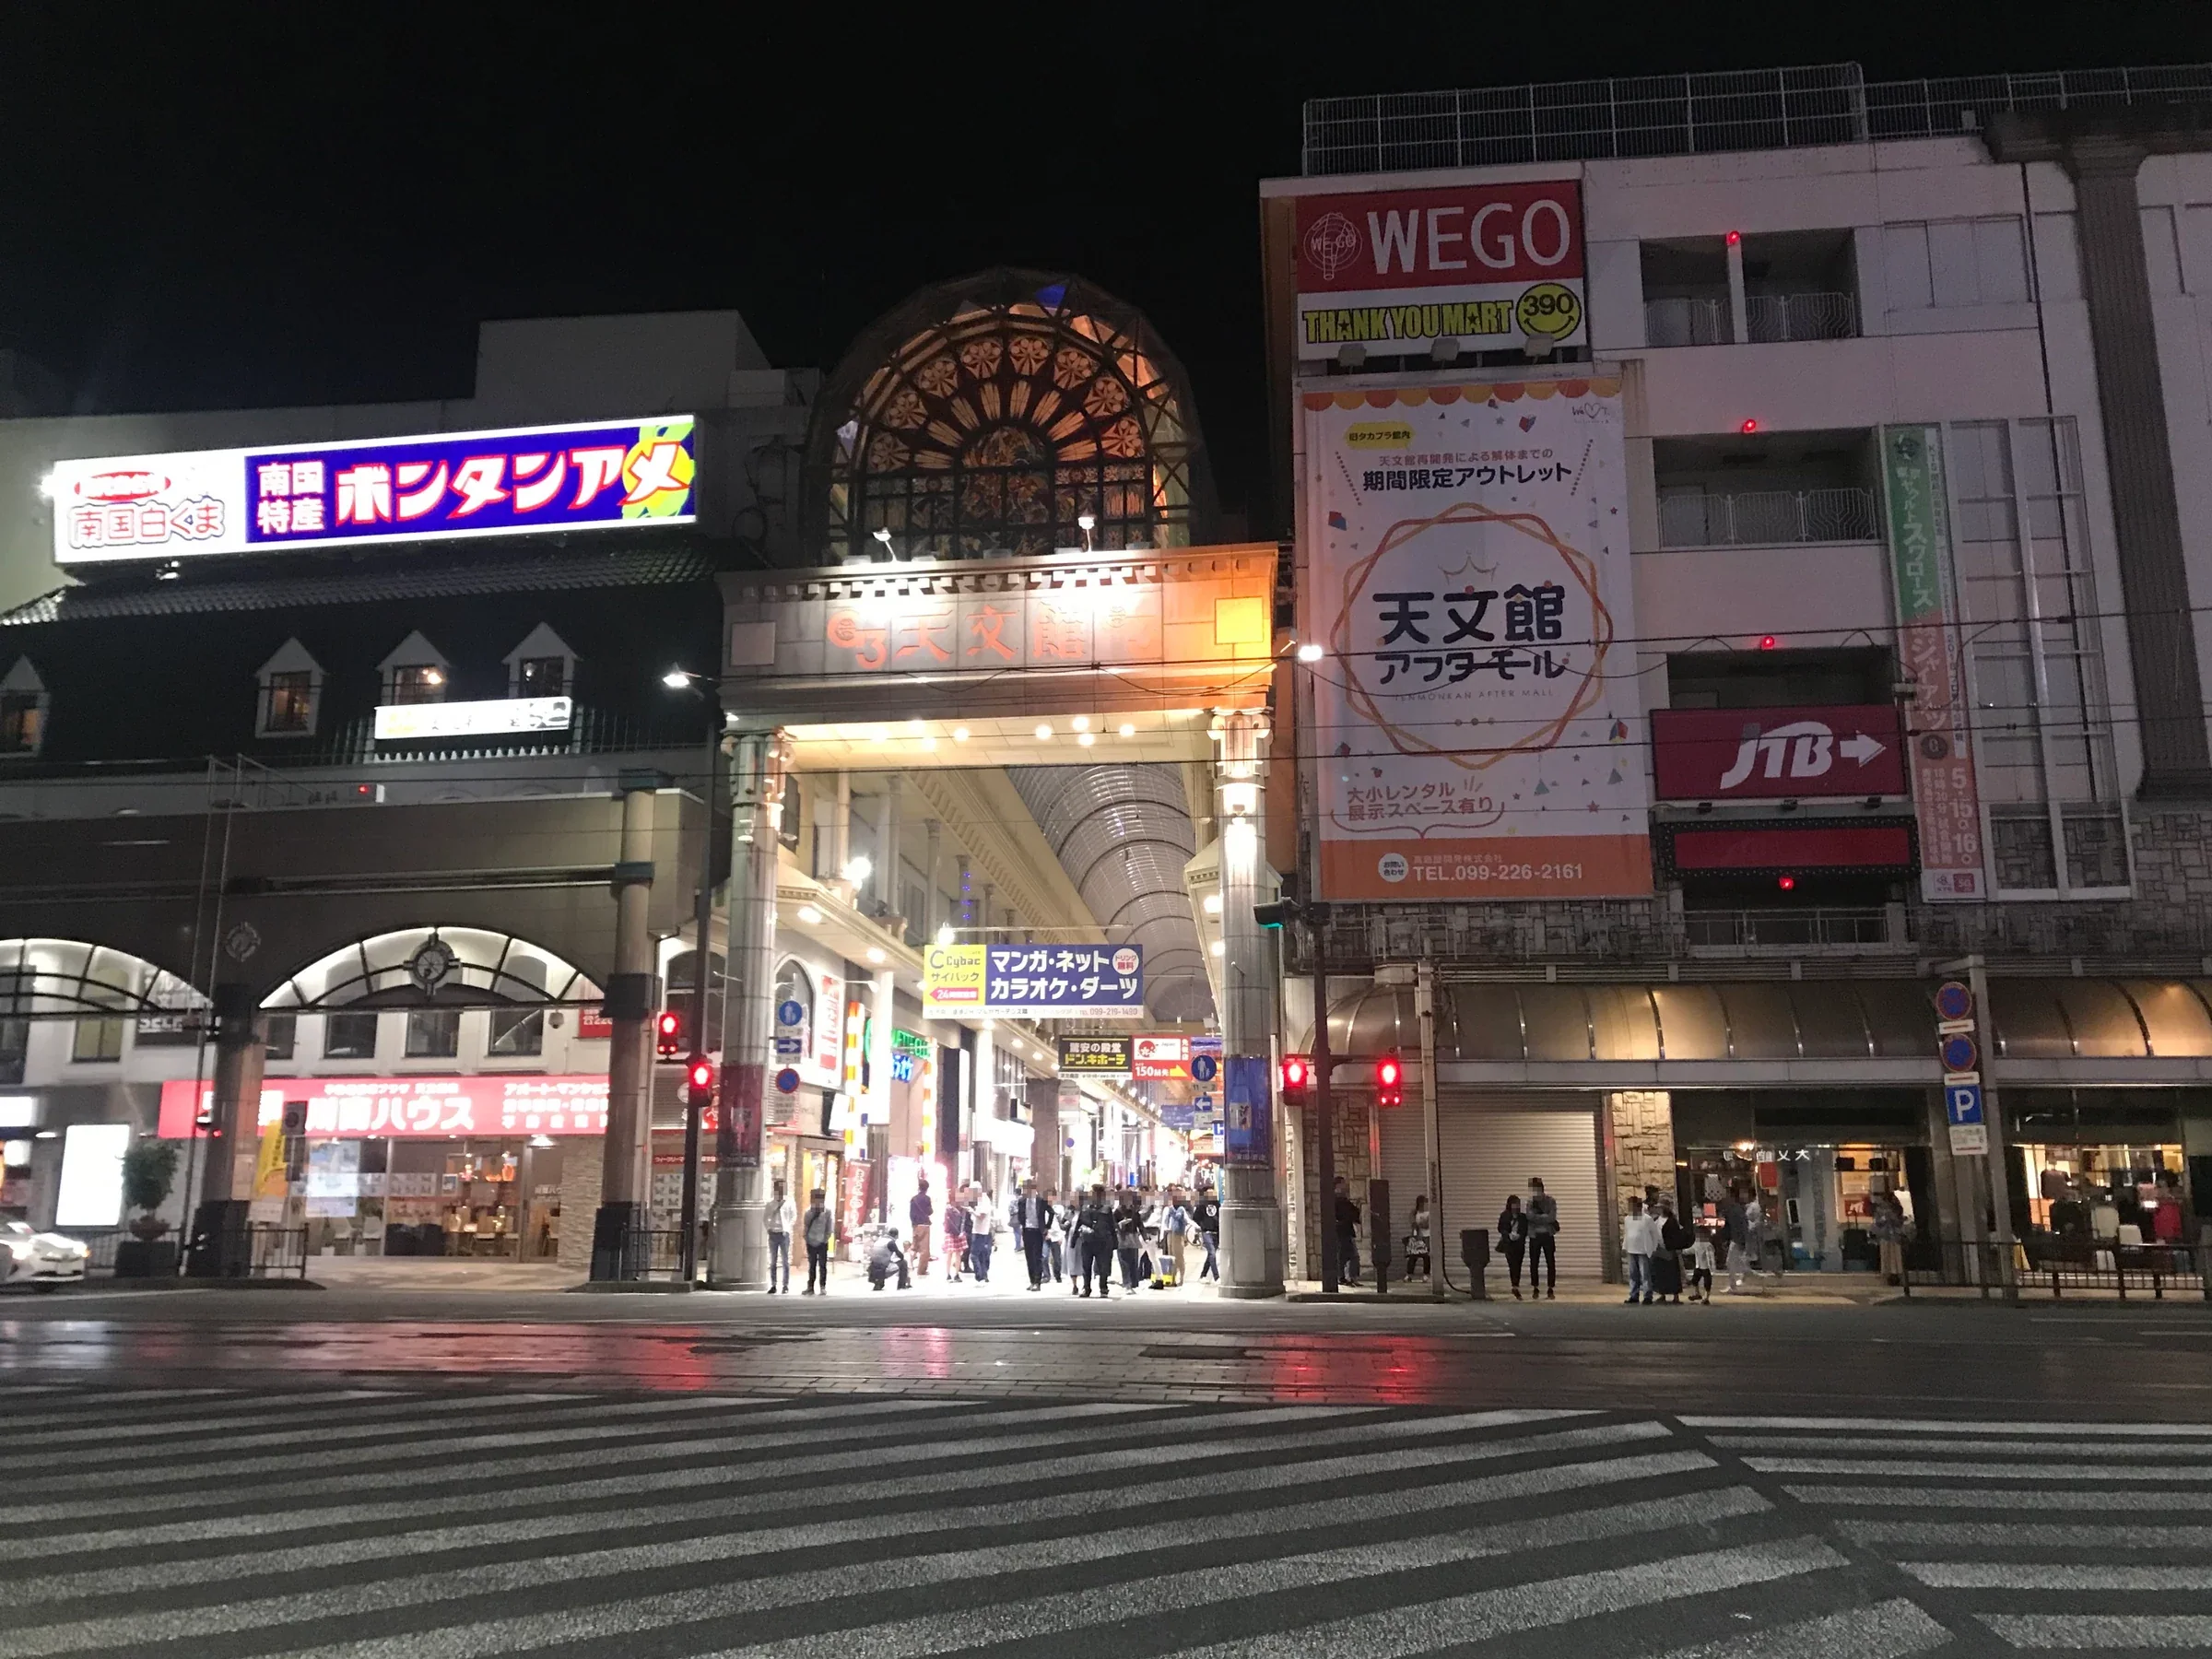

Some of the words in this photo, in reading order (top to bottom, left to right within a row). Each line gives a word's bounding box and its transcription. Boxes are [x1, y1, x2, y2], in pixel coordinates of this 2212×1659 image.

[1367, 199, 1571, 274] WEGO
[1524, 292, 1574, 316] 390
[1302, 308, 1390, 345] THANK
[1387, 305, 1441, 339] YOU
[1441, 300, 1514, 336] MART
[257, 460, 325, 497] 南国
[335, 441, 692, 526] ボンタンアメ
[1362, 461, 1573, 492] 期間限定アウトレット
[73, 502, 221, 544] 南国白くま
[257, 498, 325, 535] 特産
[1371, 582, 1566, 645] 天文館
[1479, 689, 1515, 700] AFTER
[1523, 688, 1555, 698] MALL
[1720, 721, 1834, 790] JTB
[1347, 782, 1456, 805] 大小レンタル
[1347, 796, 1494, 821] 展示スペース有り
[1413, 863, 1583, 882] TEL.099-226-2161
[946, 955, 981, 968] Cybac
[990, 948, 1110, 973] マンガ・ネット
[990, 976, 1138, 1000] カラオケ・ダーツ
[1954, 1089, 1974, 1121] P
